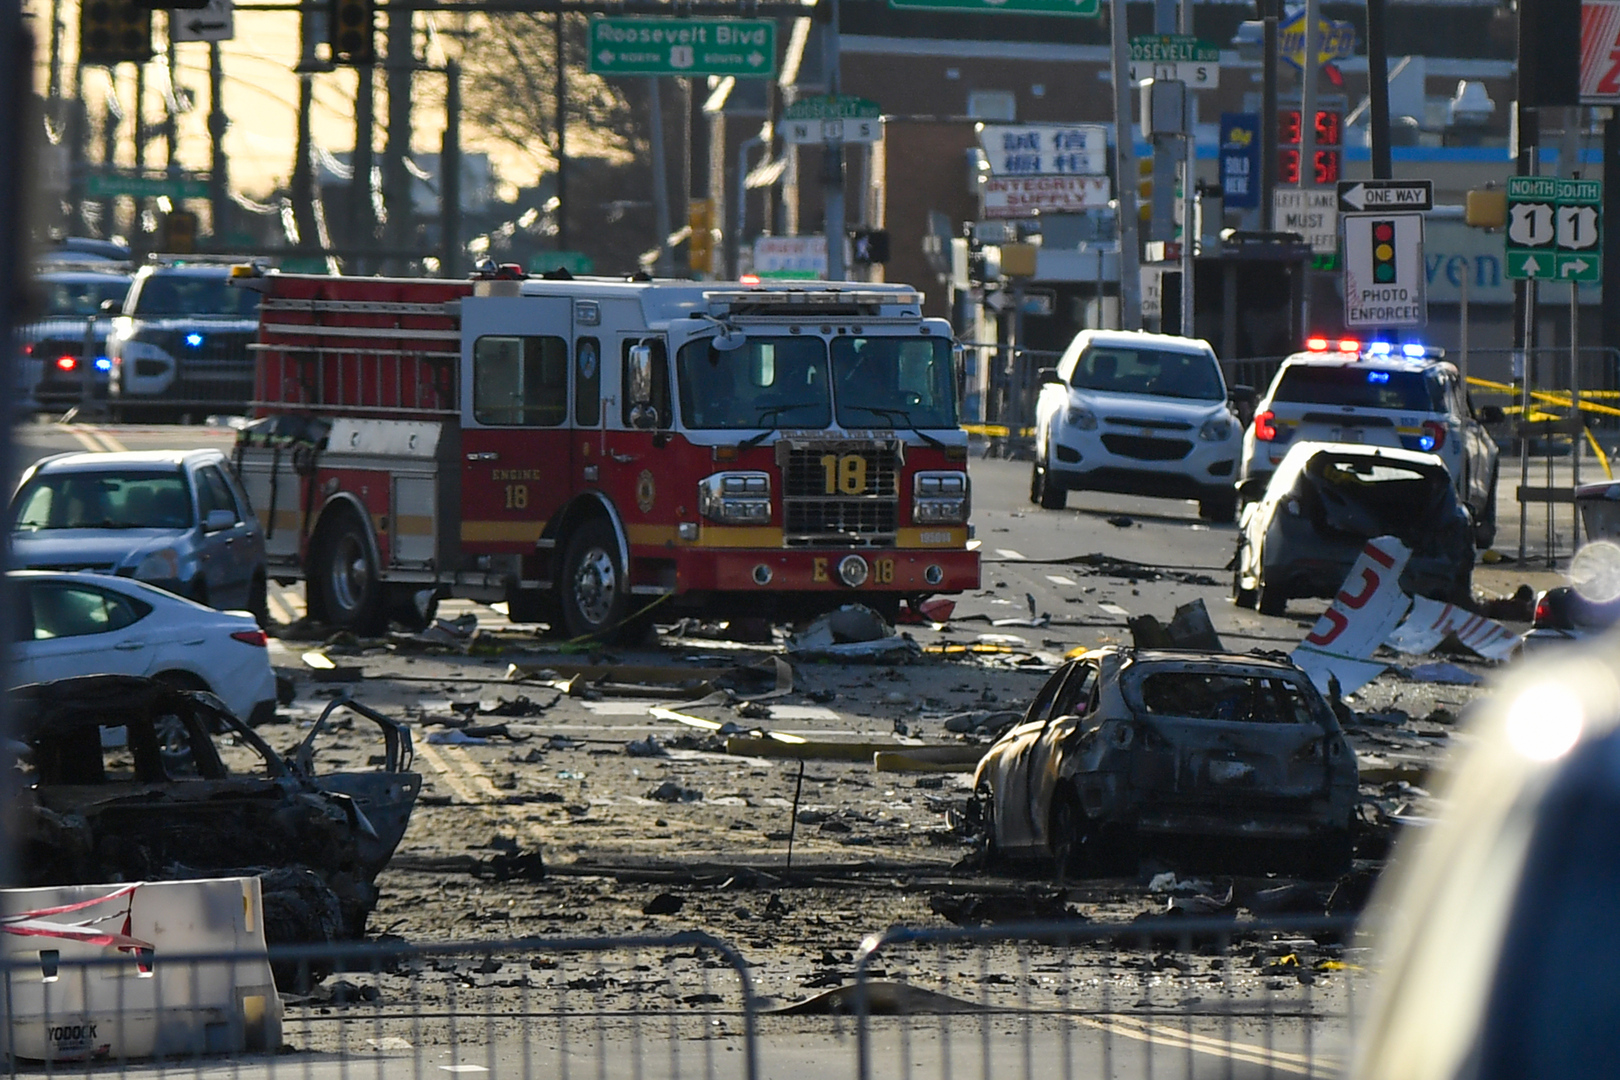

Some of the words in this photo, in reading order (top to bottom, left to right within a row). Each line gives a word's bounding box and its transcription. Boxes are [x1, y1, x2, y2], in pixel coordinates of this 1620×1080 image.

[596, 24, 707, 44] Roosevelt
[716, 26, 767, 45] Blvd
[620, 53, 661, 63] NORTH
[1127, 43, 1195, 60] OOSEVELT
[1197, 67, 1207, 81] S
[861, 123, 871, 138] S
[986, 178, 1105, 192] INTEGRITY
[1512, 181, 1554, 195] NORTH
[1557, 183, 1597, 198] SOUTH
[1006, 194, 1086, 205] SUPPLY
[1365, 190, 1391, 203] ONE
[1396, 190, 1423, 203] WAY
[1286, 213, 1323, 228] MUST
[1524, 209, 1536, 239] 1
[1568, 212, 1580, 242] 1
[1362, 289, 1408, 302] PHOTO
[492, 469, 541, 481] ENGINE
[821, 454, 867, 495] 18
[505, 484, 528, 509] 18
[814, 557, 829, 582] E
[874, 558, 895, 583] 18
[48, 1024, 97, 1041] YODOCK
